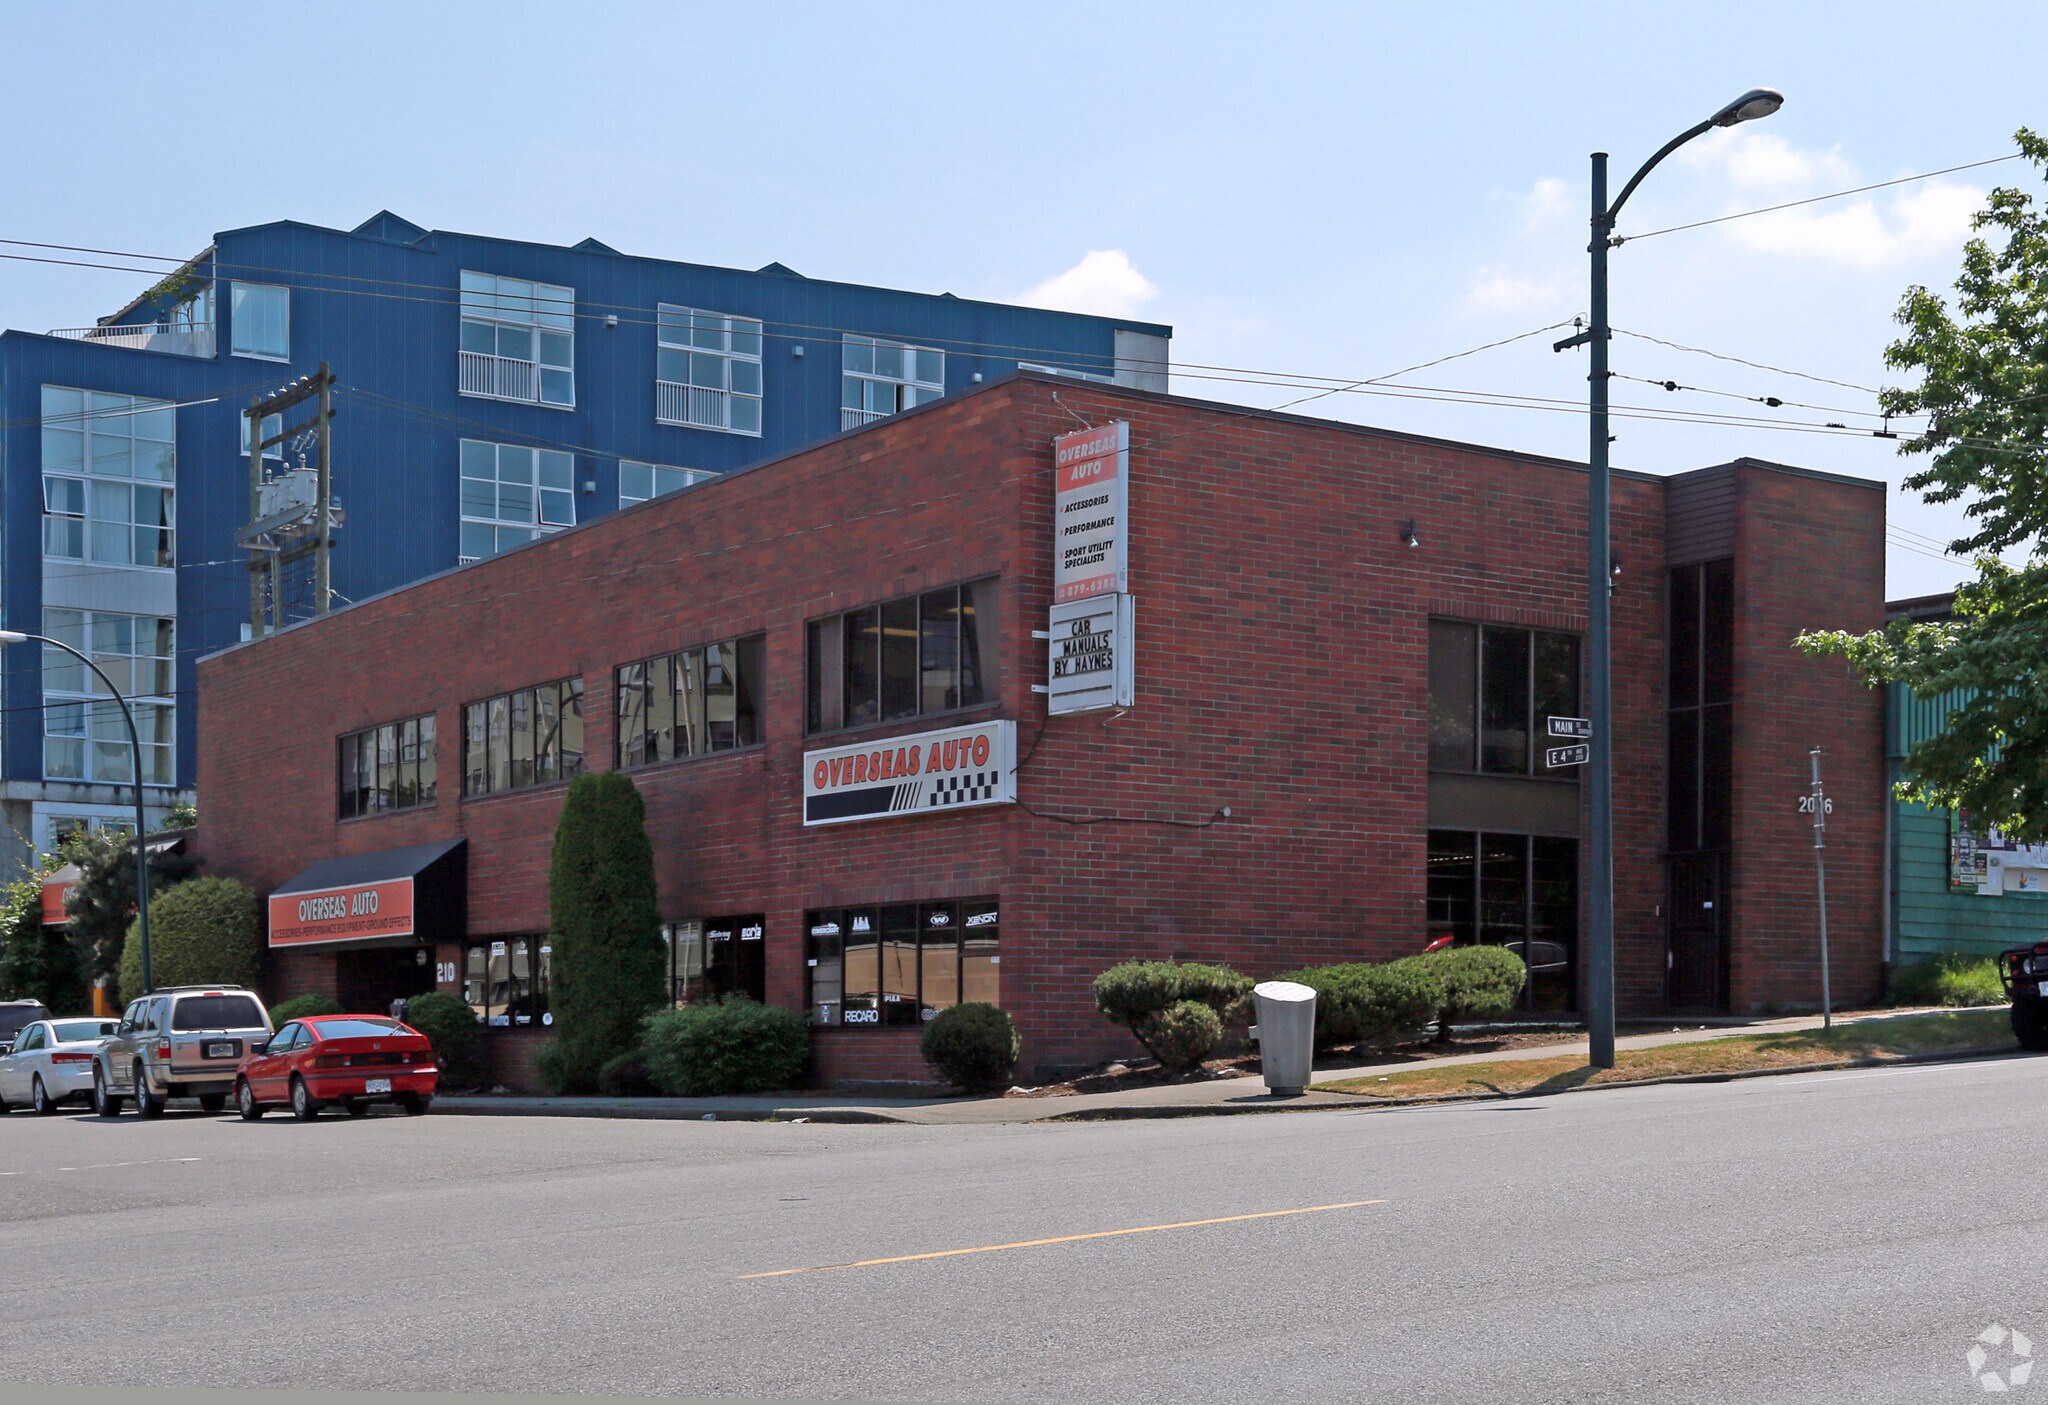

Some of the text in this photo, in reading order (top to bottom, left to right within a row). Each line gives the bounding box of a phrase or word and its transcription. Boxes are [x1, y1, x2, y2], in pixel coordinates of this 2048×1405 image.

[1059, 436, 1117, 463] OVERSEAS
[1071, 461, 1102, 481] AUTO
[1064, 494, 1109, 513] ACCESSORIES
[1064, 516, 1115, 536] PERFORMANCE
[1064, 540, 1113, 559] SPORT UTILITY
[1064, 552, 1105, 569] SPECIALISTS
[1071, 620, 1091, 636] CAR
[1063, 634, 1109, 656] MANUALS
[1055, 652, 1112, 675] BY HAYNES
[1555, 721, 1573, 733] MAIN
[813, 735, 990, 789] OVERSEAS AUTO
[1552, 752, 1558, 763] E
[1799, 796, 1832, 814] 206
[298, 890, 379, 922] OVERSEAS AUTO
[437, 962, 455, 982] 210
[845, 1010, 878, 1022] RECARO
